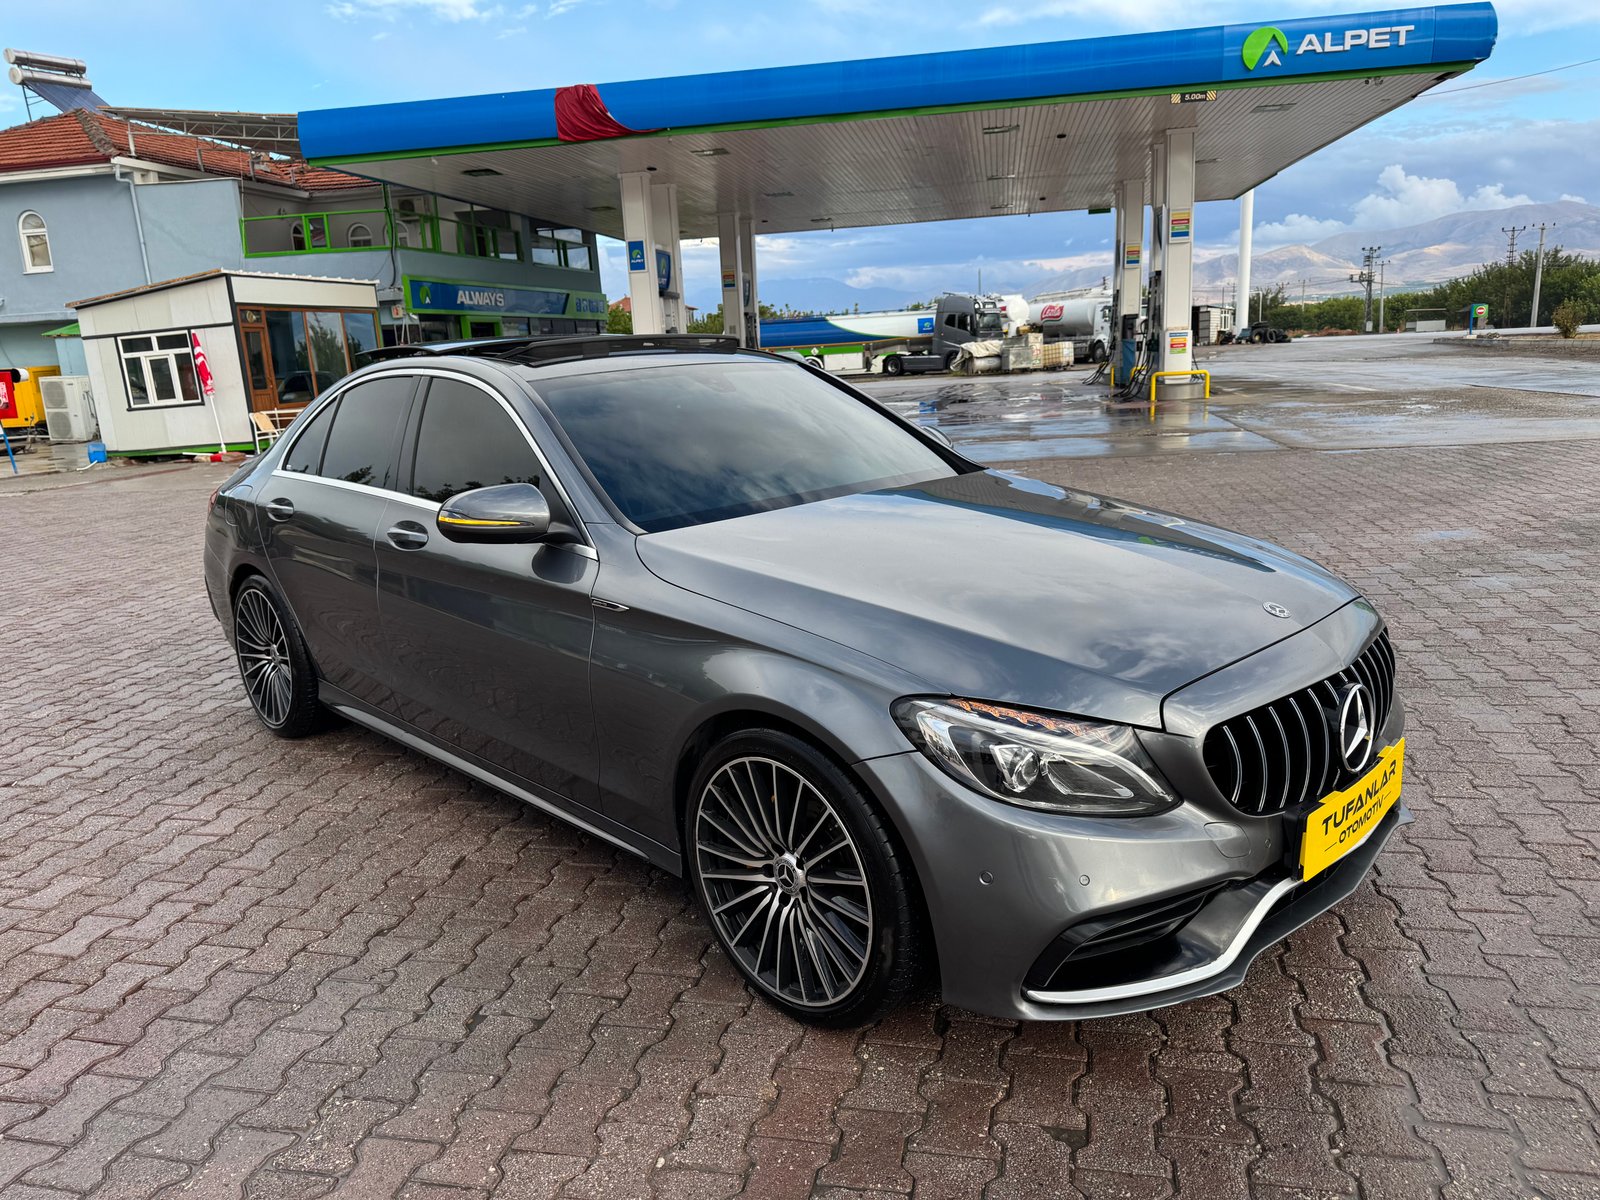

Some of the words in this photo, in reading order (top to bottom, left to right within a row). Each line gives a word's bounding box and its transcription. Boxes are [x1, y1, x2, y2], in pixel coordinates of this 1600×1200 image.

[1296, 25, 1415, 55] ALPET
[1184, 93, 1206, 101] 5.00m
[456, 290, 505, 307] ALWAYS
[1321, 759, 1397, 836] TUFANLAR
[1338, 795, 1384, 844] OTOMOTİV
